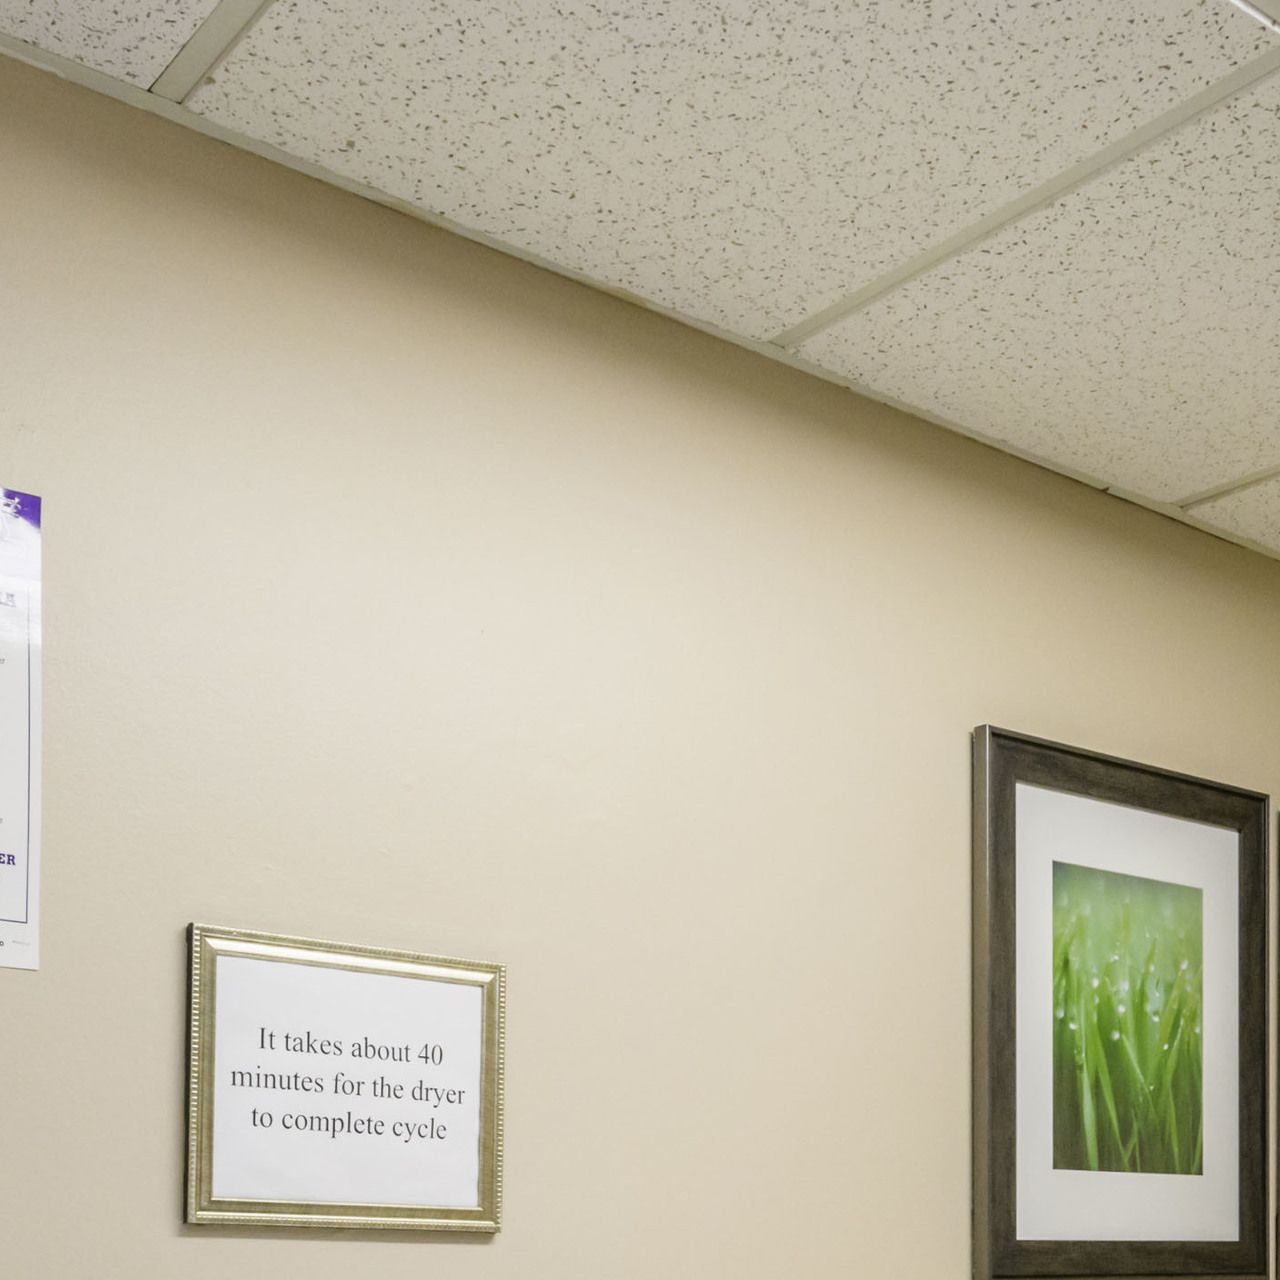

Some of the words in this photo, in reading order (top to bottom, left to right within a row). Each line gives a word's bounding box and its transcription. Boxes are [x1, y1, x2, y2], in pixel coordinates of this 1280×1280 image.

[260, 1027, 275, 1050] It
[284, 1031, 343, 1056] takes
[351, 1036, 410, 1063] about
[417, 1043, 443, 1065] 40
[231, 1065, 324, 1093] minutes
[334, 1072, 365, 1096] for
[372, 1076, 404, 1100] the
[411, 1080, 465, 1109] dryer
[252, 1108, 273, 1128] to
[281, 1111, 385, 1138] complete
[392, 1117, 447, 1143] cycle
